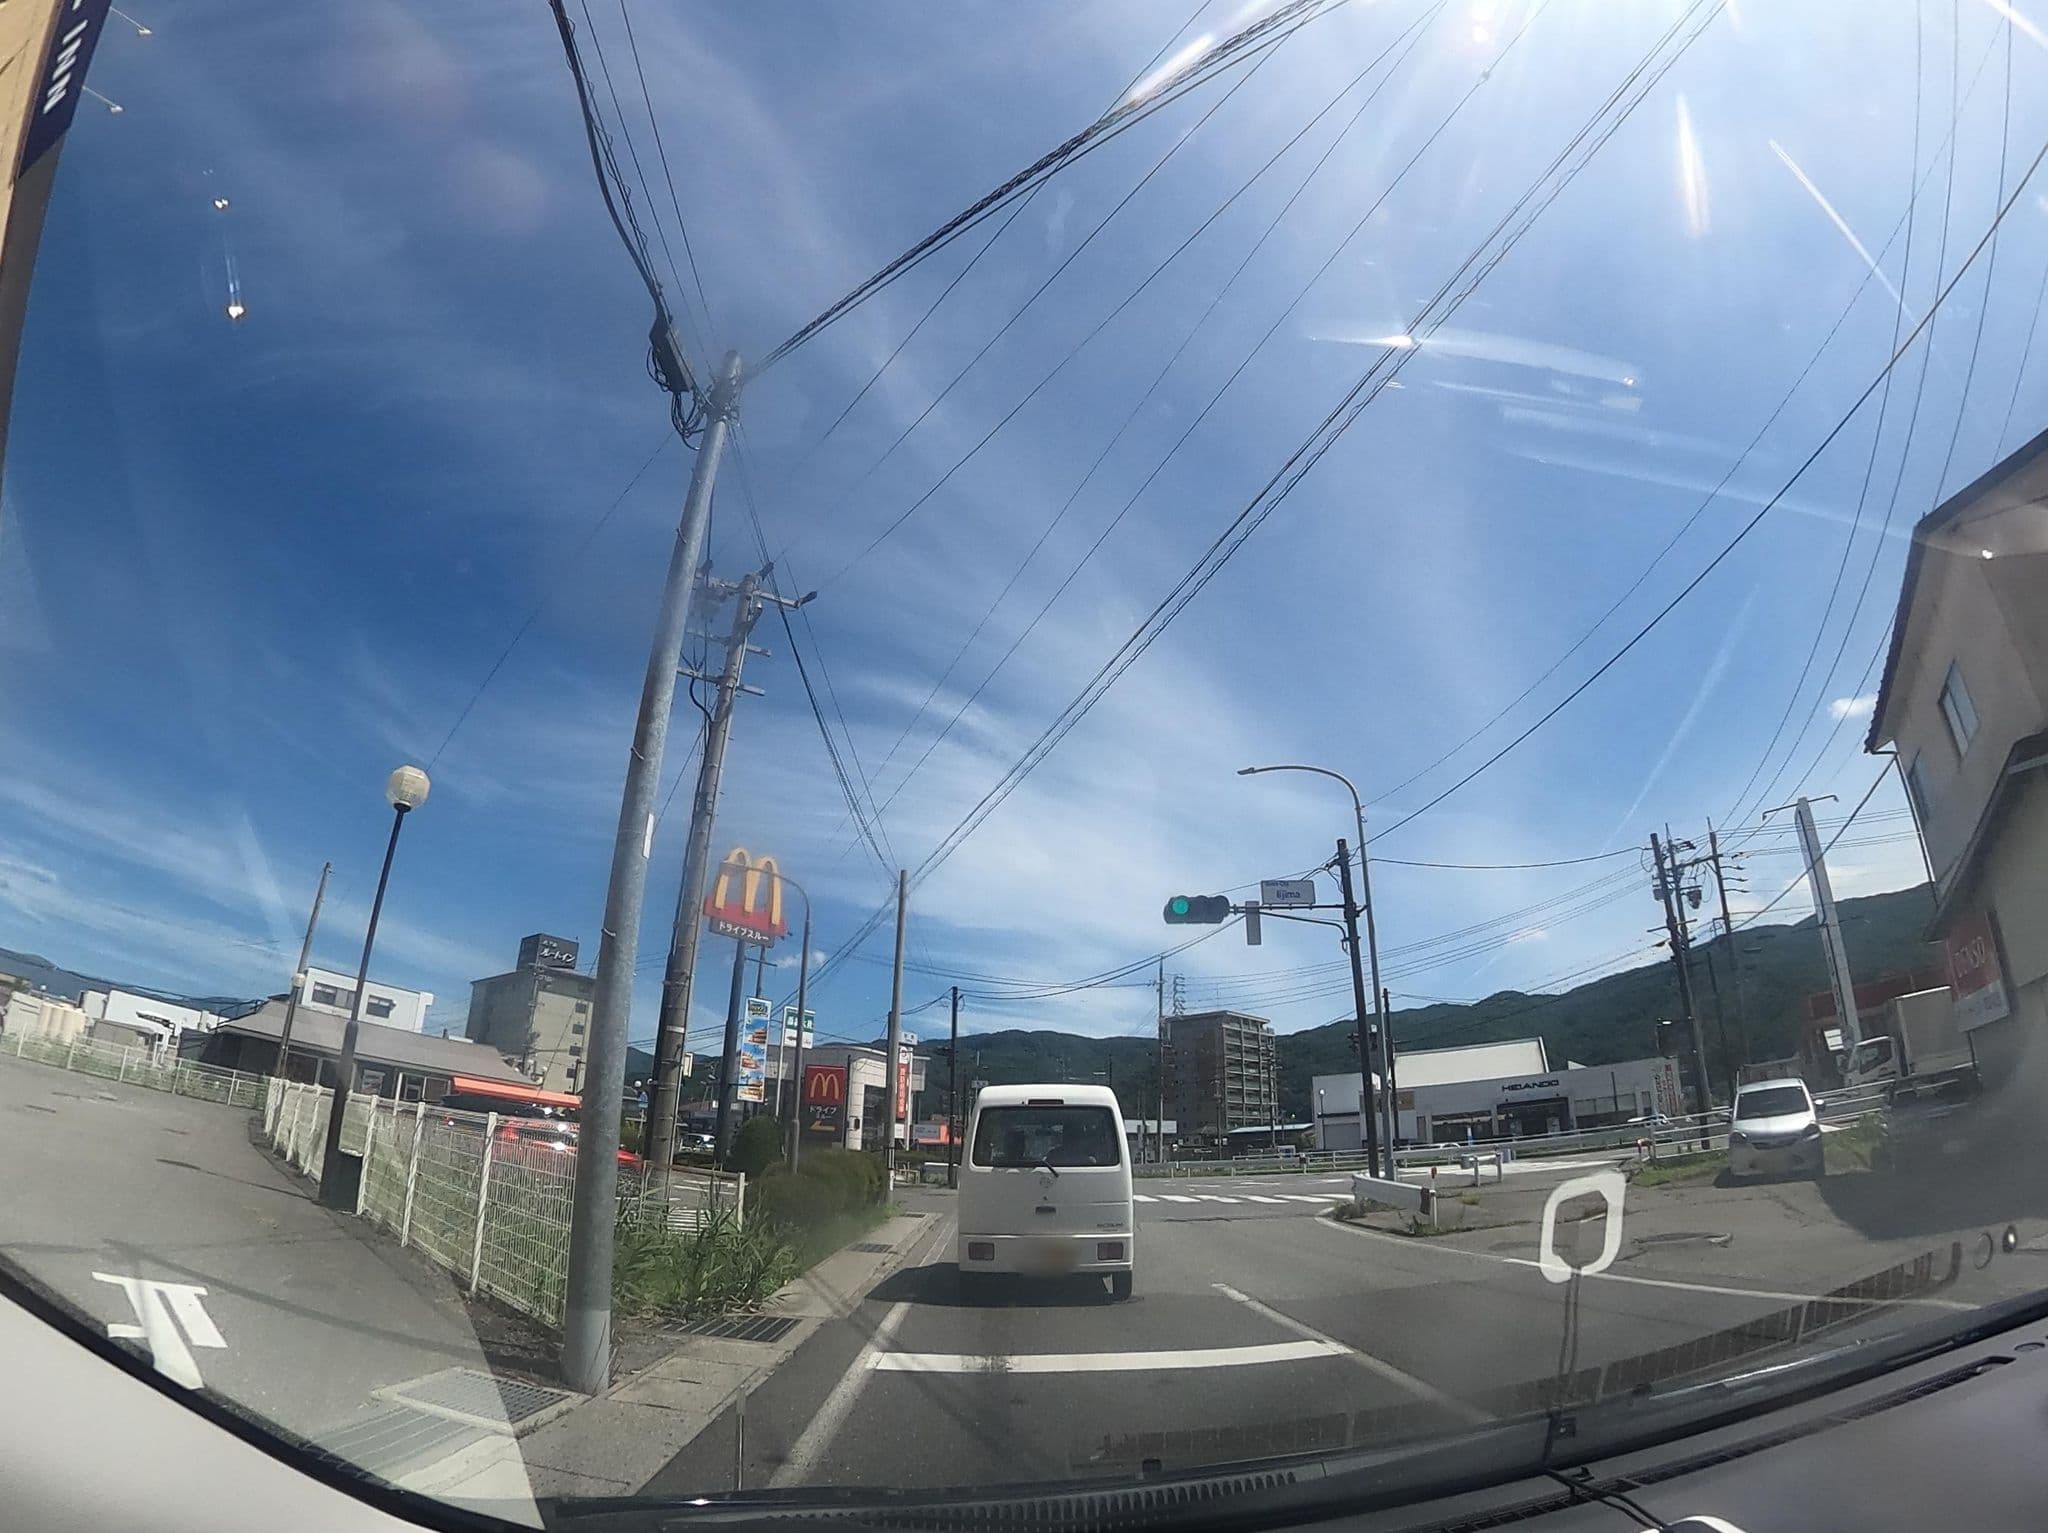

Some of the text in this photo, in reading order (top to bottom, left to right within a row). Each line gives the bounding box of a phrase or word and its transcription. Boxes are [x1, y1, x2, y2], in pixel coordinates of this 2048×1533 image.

[719, 921, 769, 941] ドライブスルー
[540, 947, 576, 962] ルートイン
